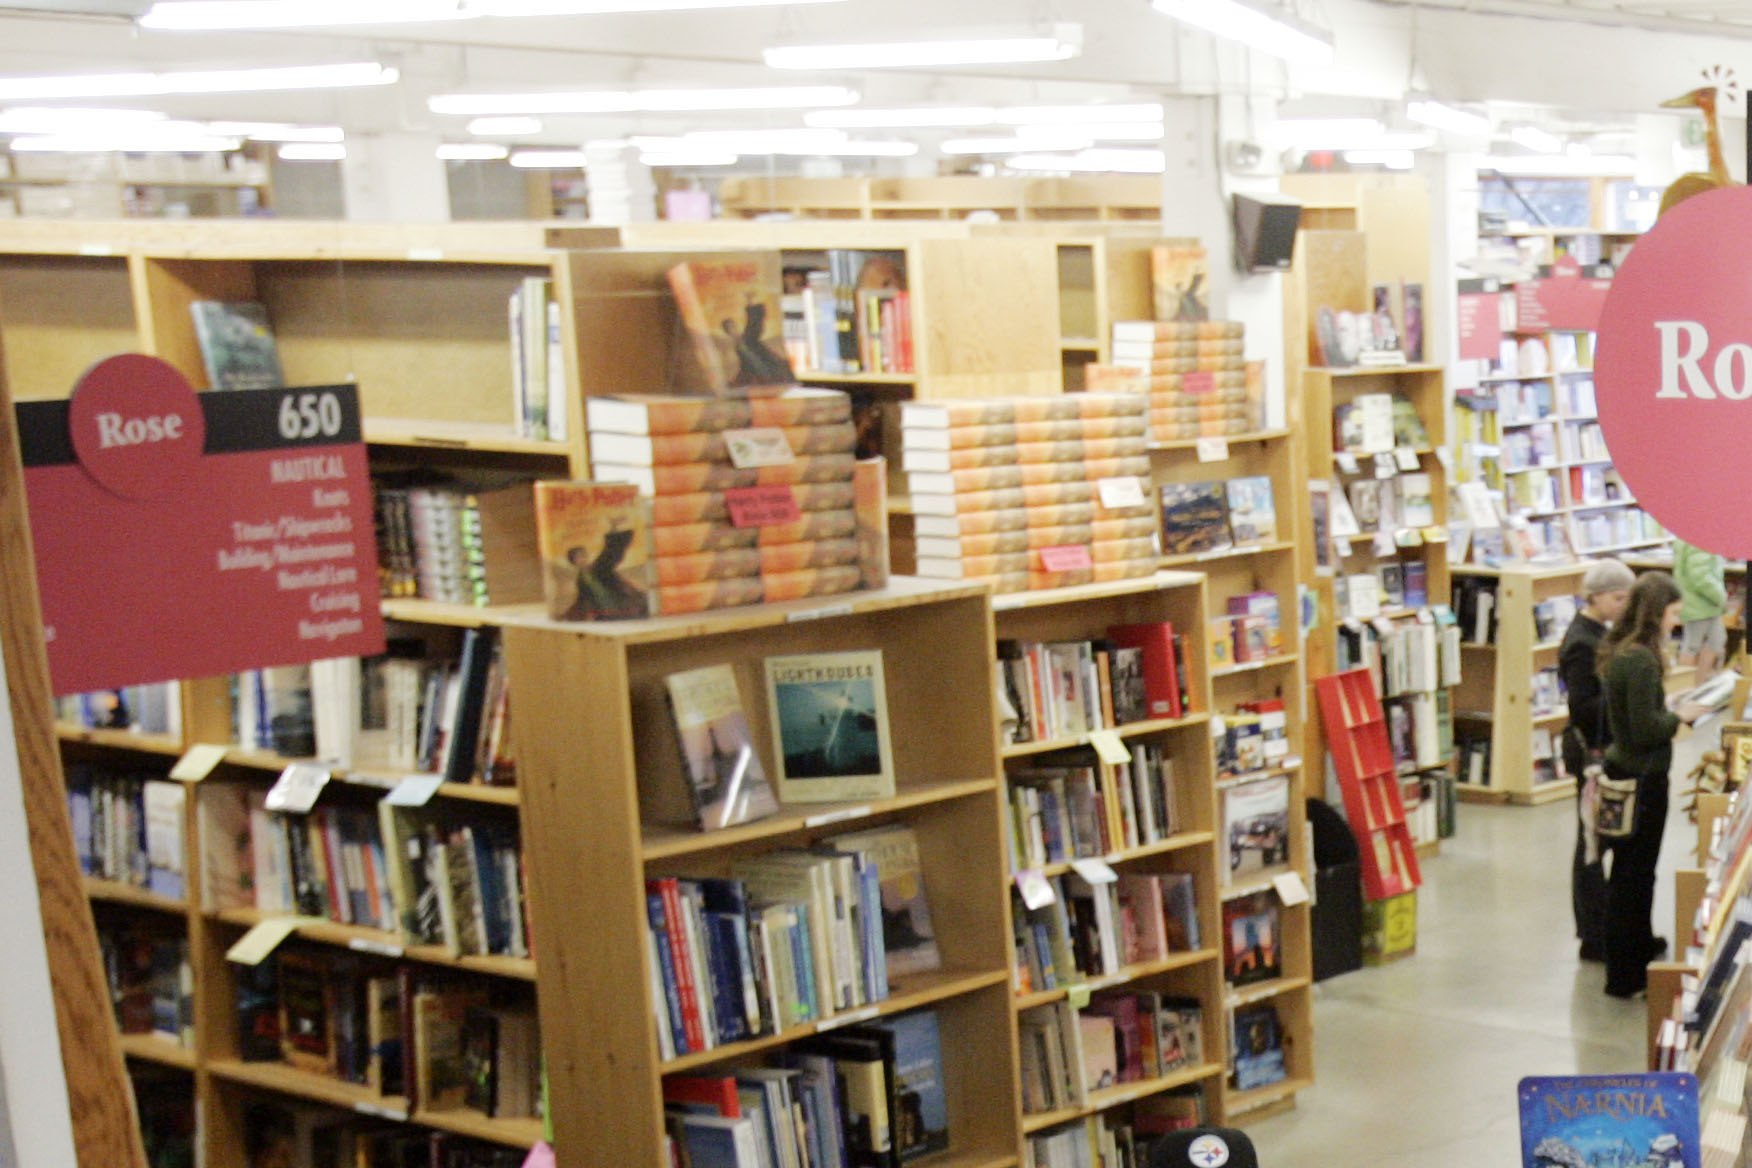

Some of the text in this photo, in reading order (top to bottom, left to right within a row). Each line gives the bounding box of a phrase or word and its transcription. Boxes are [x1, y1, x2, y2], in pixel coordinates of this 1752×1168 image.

[95, 411, 183, 450] Rose
[277, 392, 342, 440] 650
[270, 456, 347, 483] NAUTICAL
[1545, 1092, 1668, 1123] NARNIA
